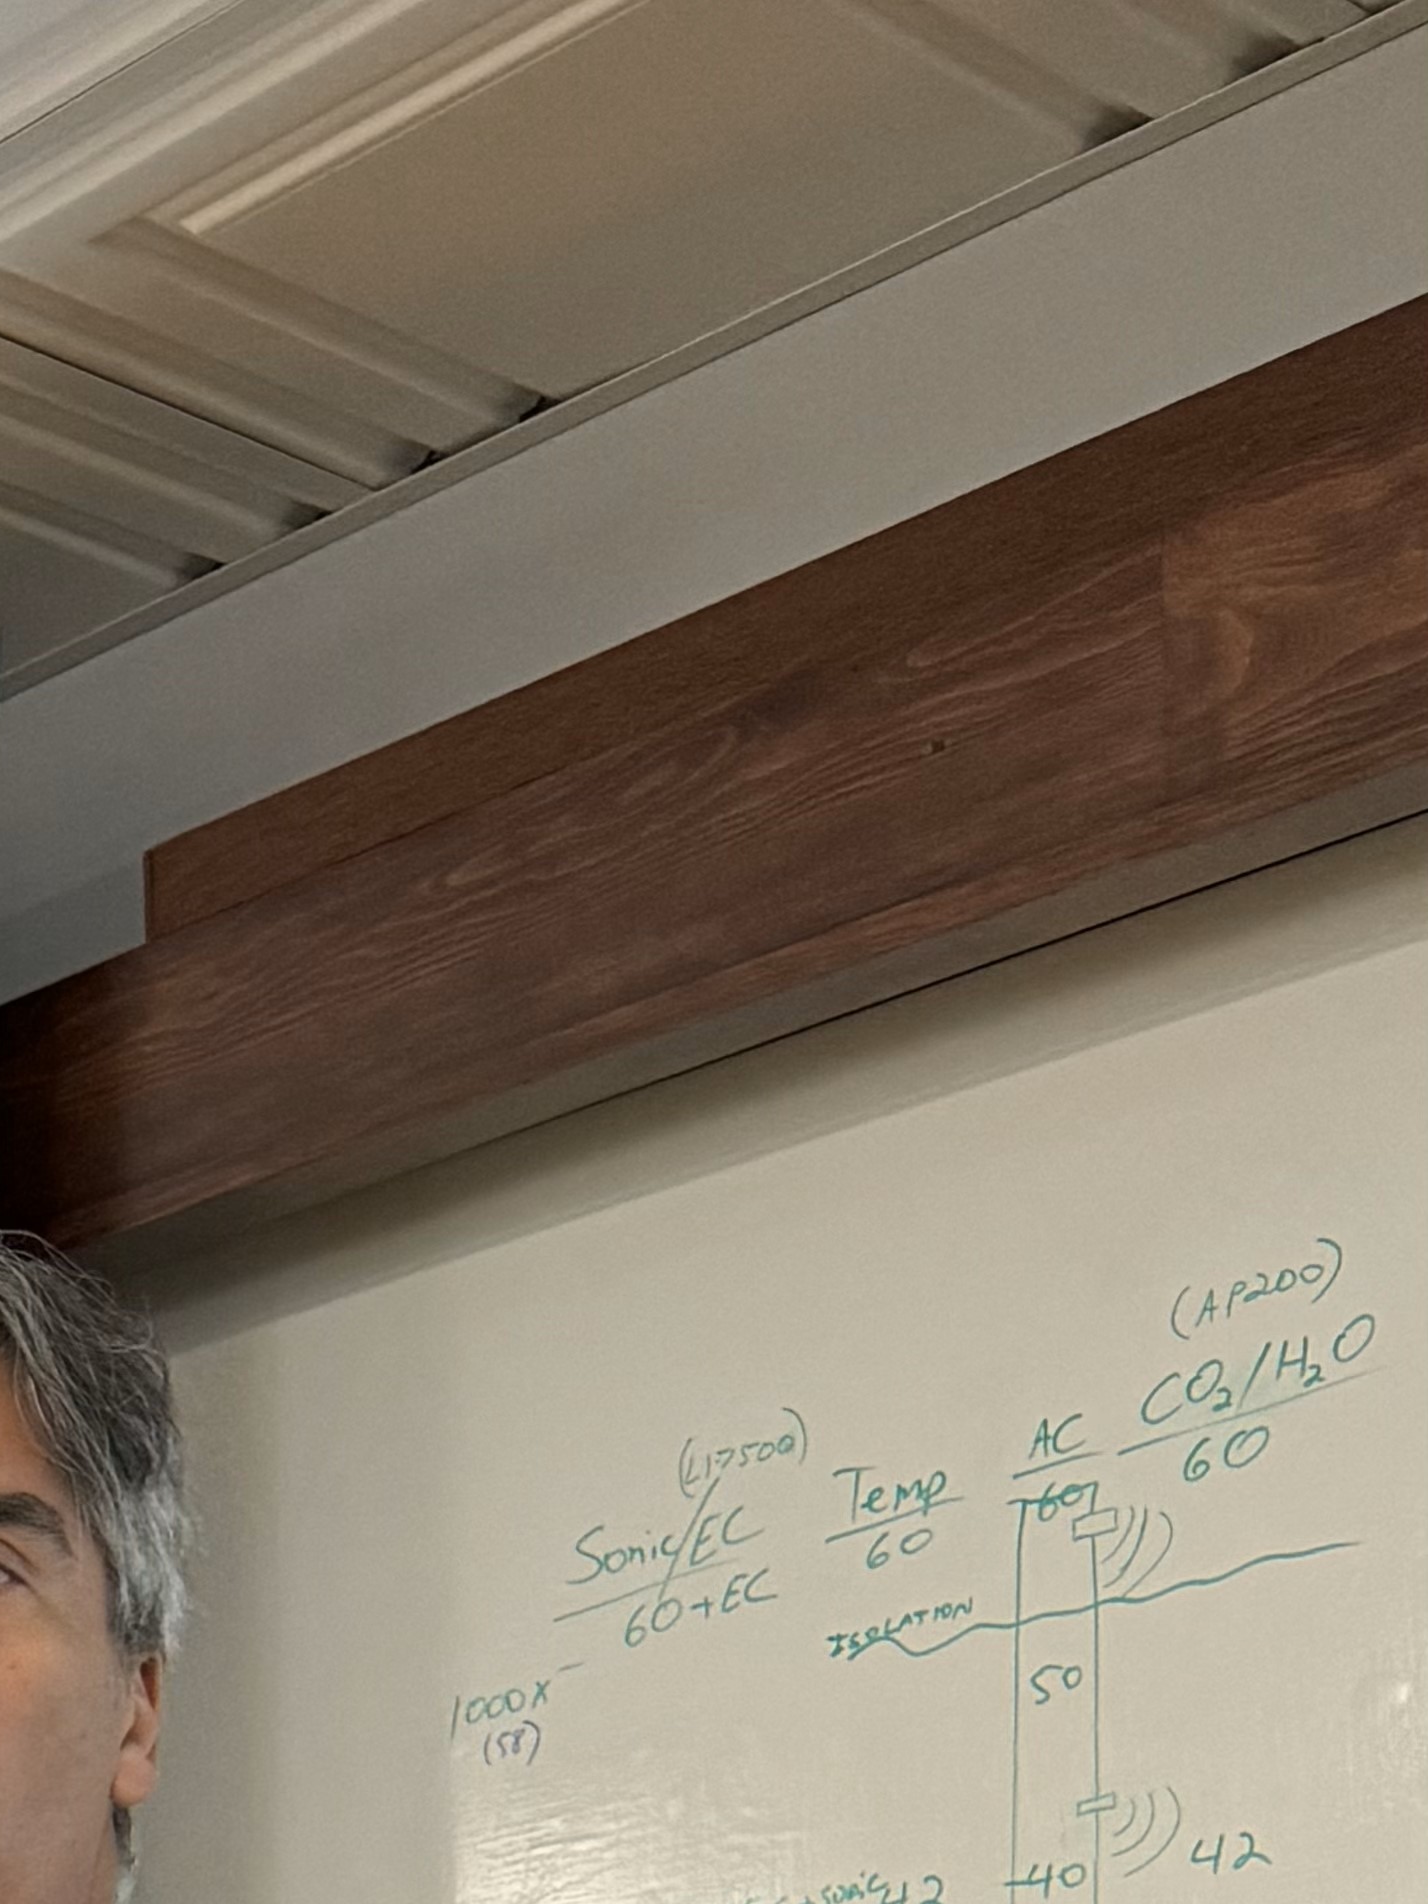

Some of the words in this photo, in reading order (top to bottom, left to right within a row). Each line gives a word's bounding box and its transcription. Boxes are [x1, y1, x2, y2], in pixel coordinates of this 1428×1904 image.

[1029, 1413, 1087, 1460] AC
[1183, 1426, 1270, 1482] 60
[832, 1466, 947, 1524] Temp
[866, 1528, 934, 1570] 60
[1030, 1664, 1082, 1705] 50
[1190, 1831, 1272, 1875] 42
[1026, 1863, 1087, 1898] 40
